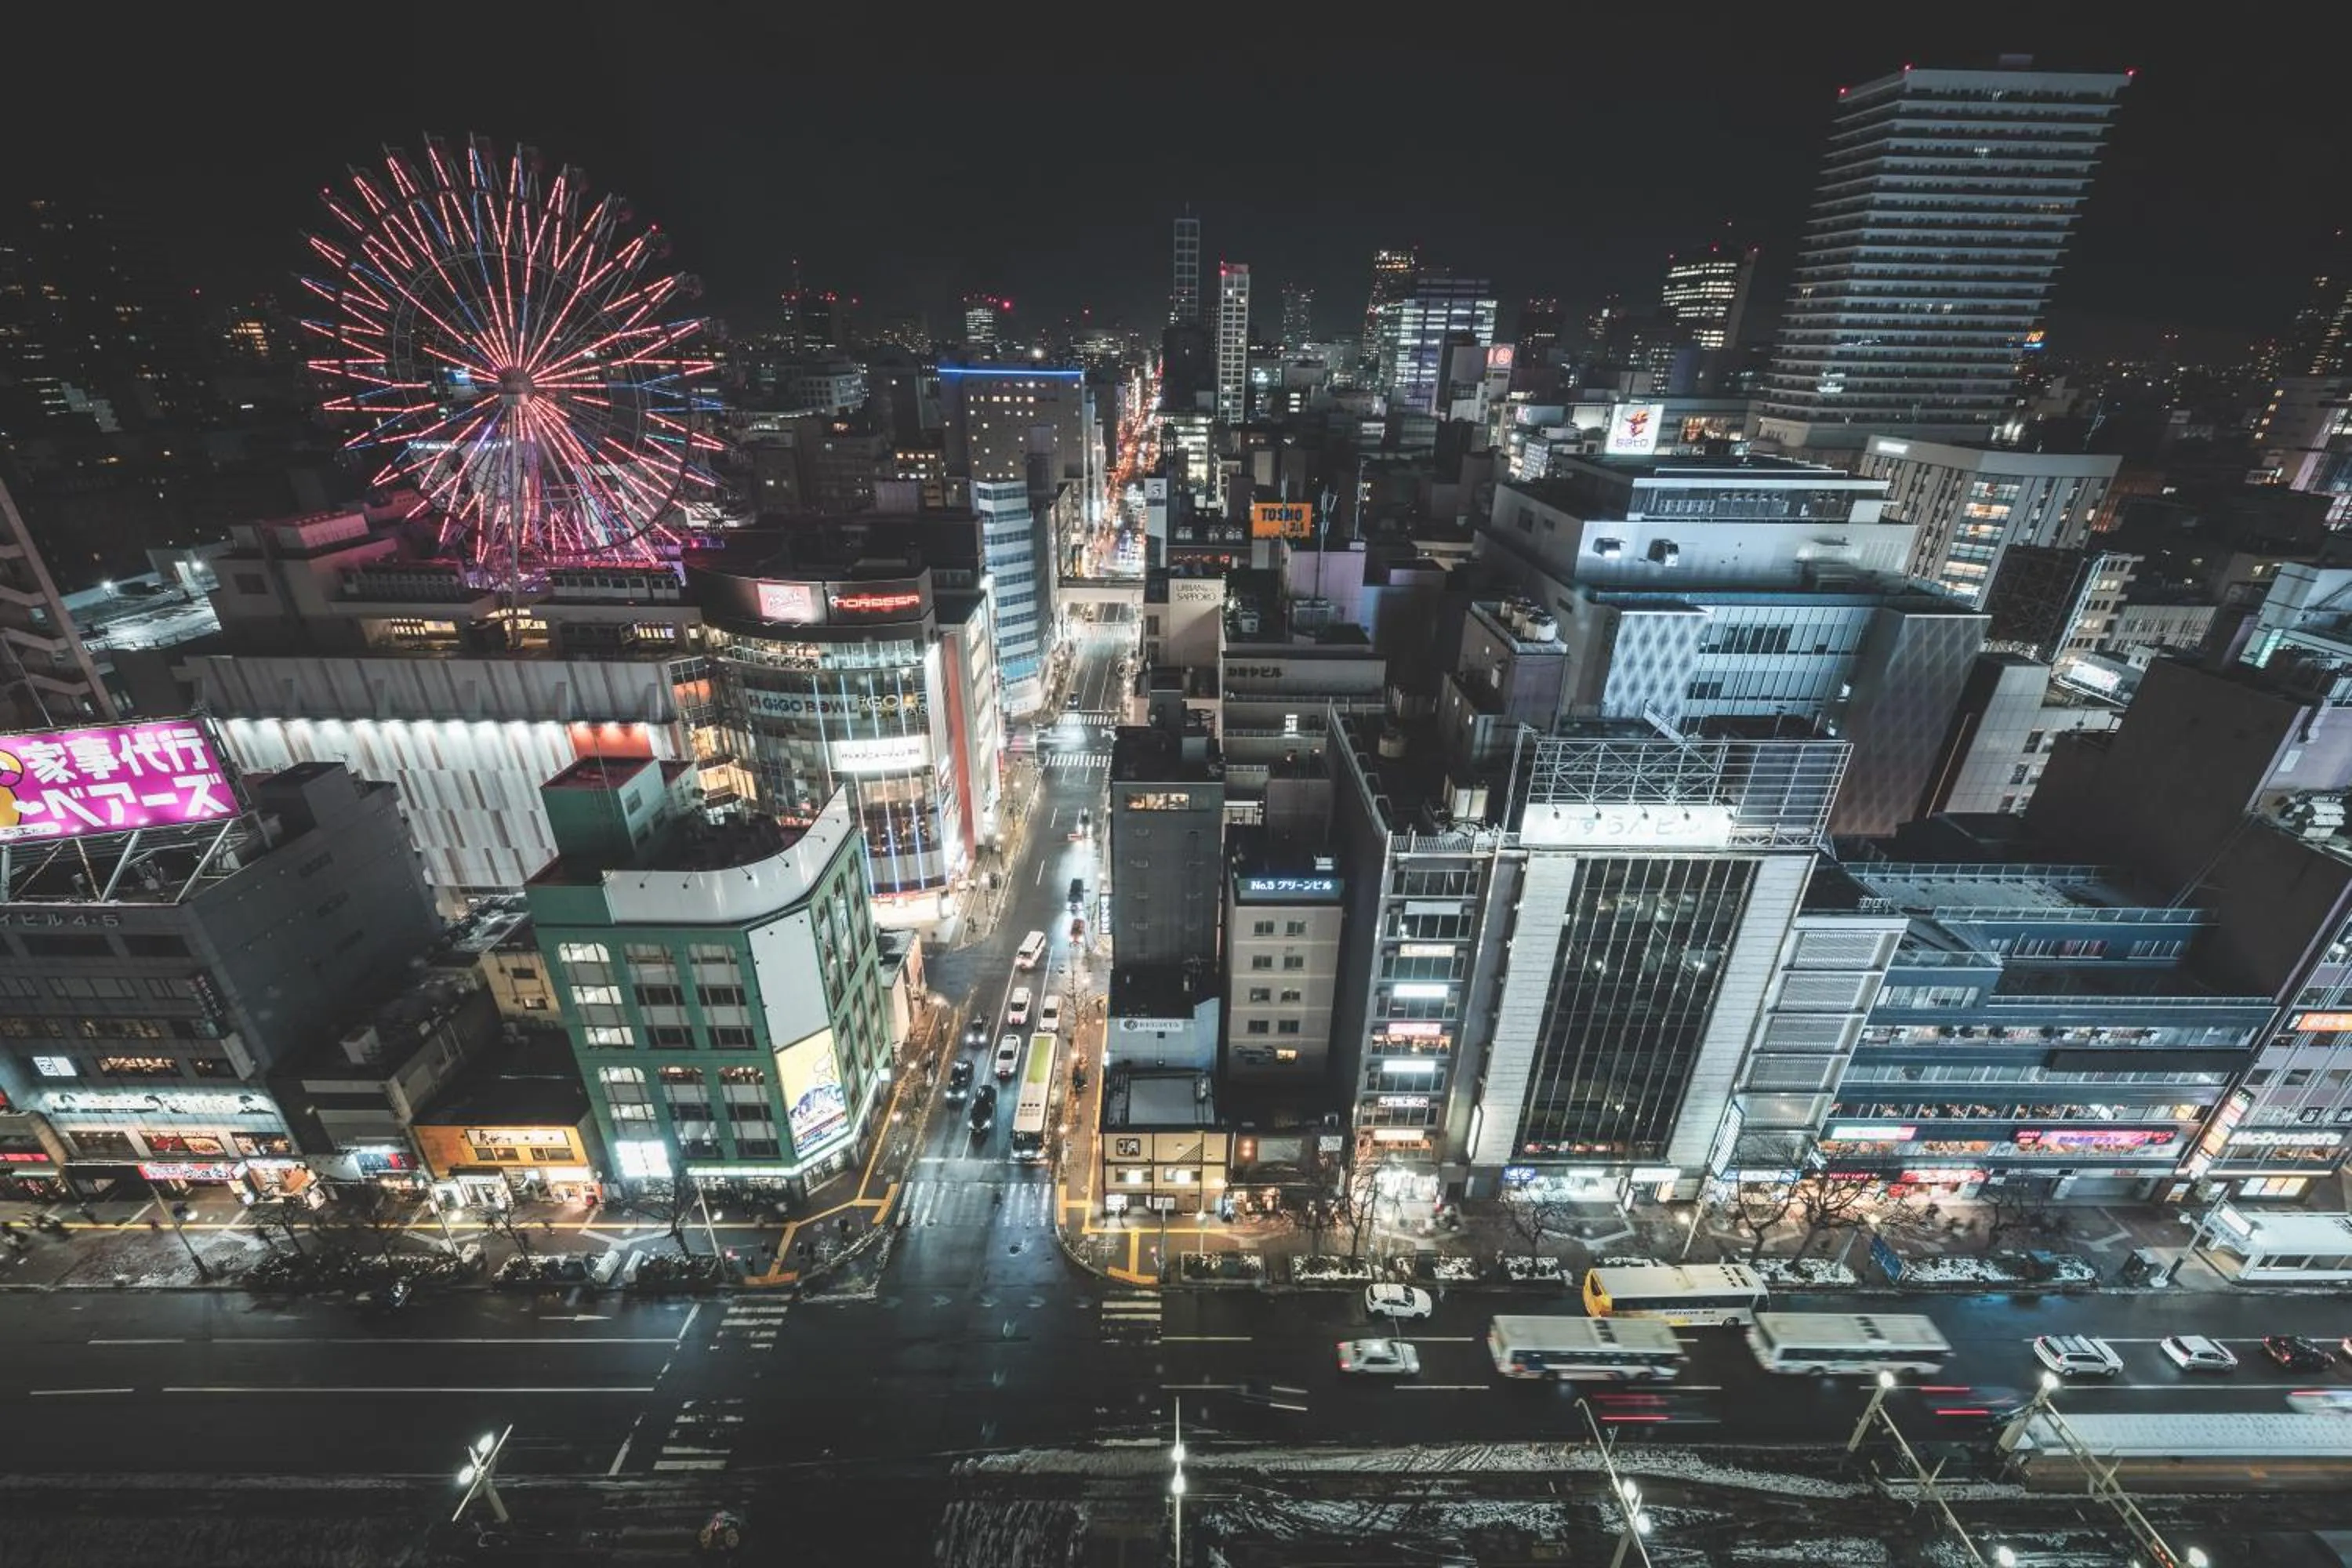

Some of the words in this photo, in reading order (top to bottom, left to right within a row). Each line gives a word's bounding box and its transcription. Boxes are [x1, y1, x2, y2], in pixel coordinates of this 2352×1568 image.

[17, 728, 210, 784] 家事代行
[41, 773, 231, 827] ベアーズ
[1277, 880, 1332, 891] グリーンビル
